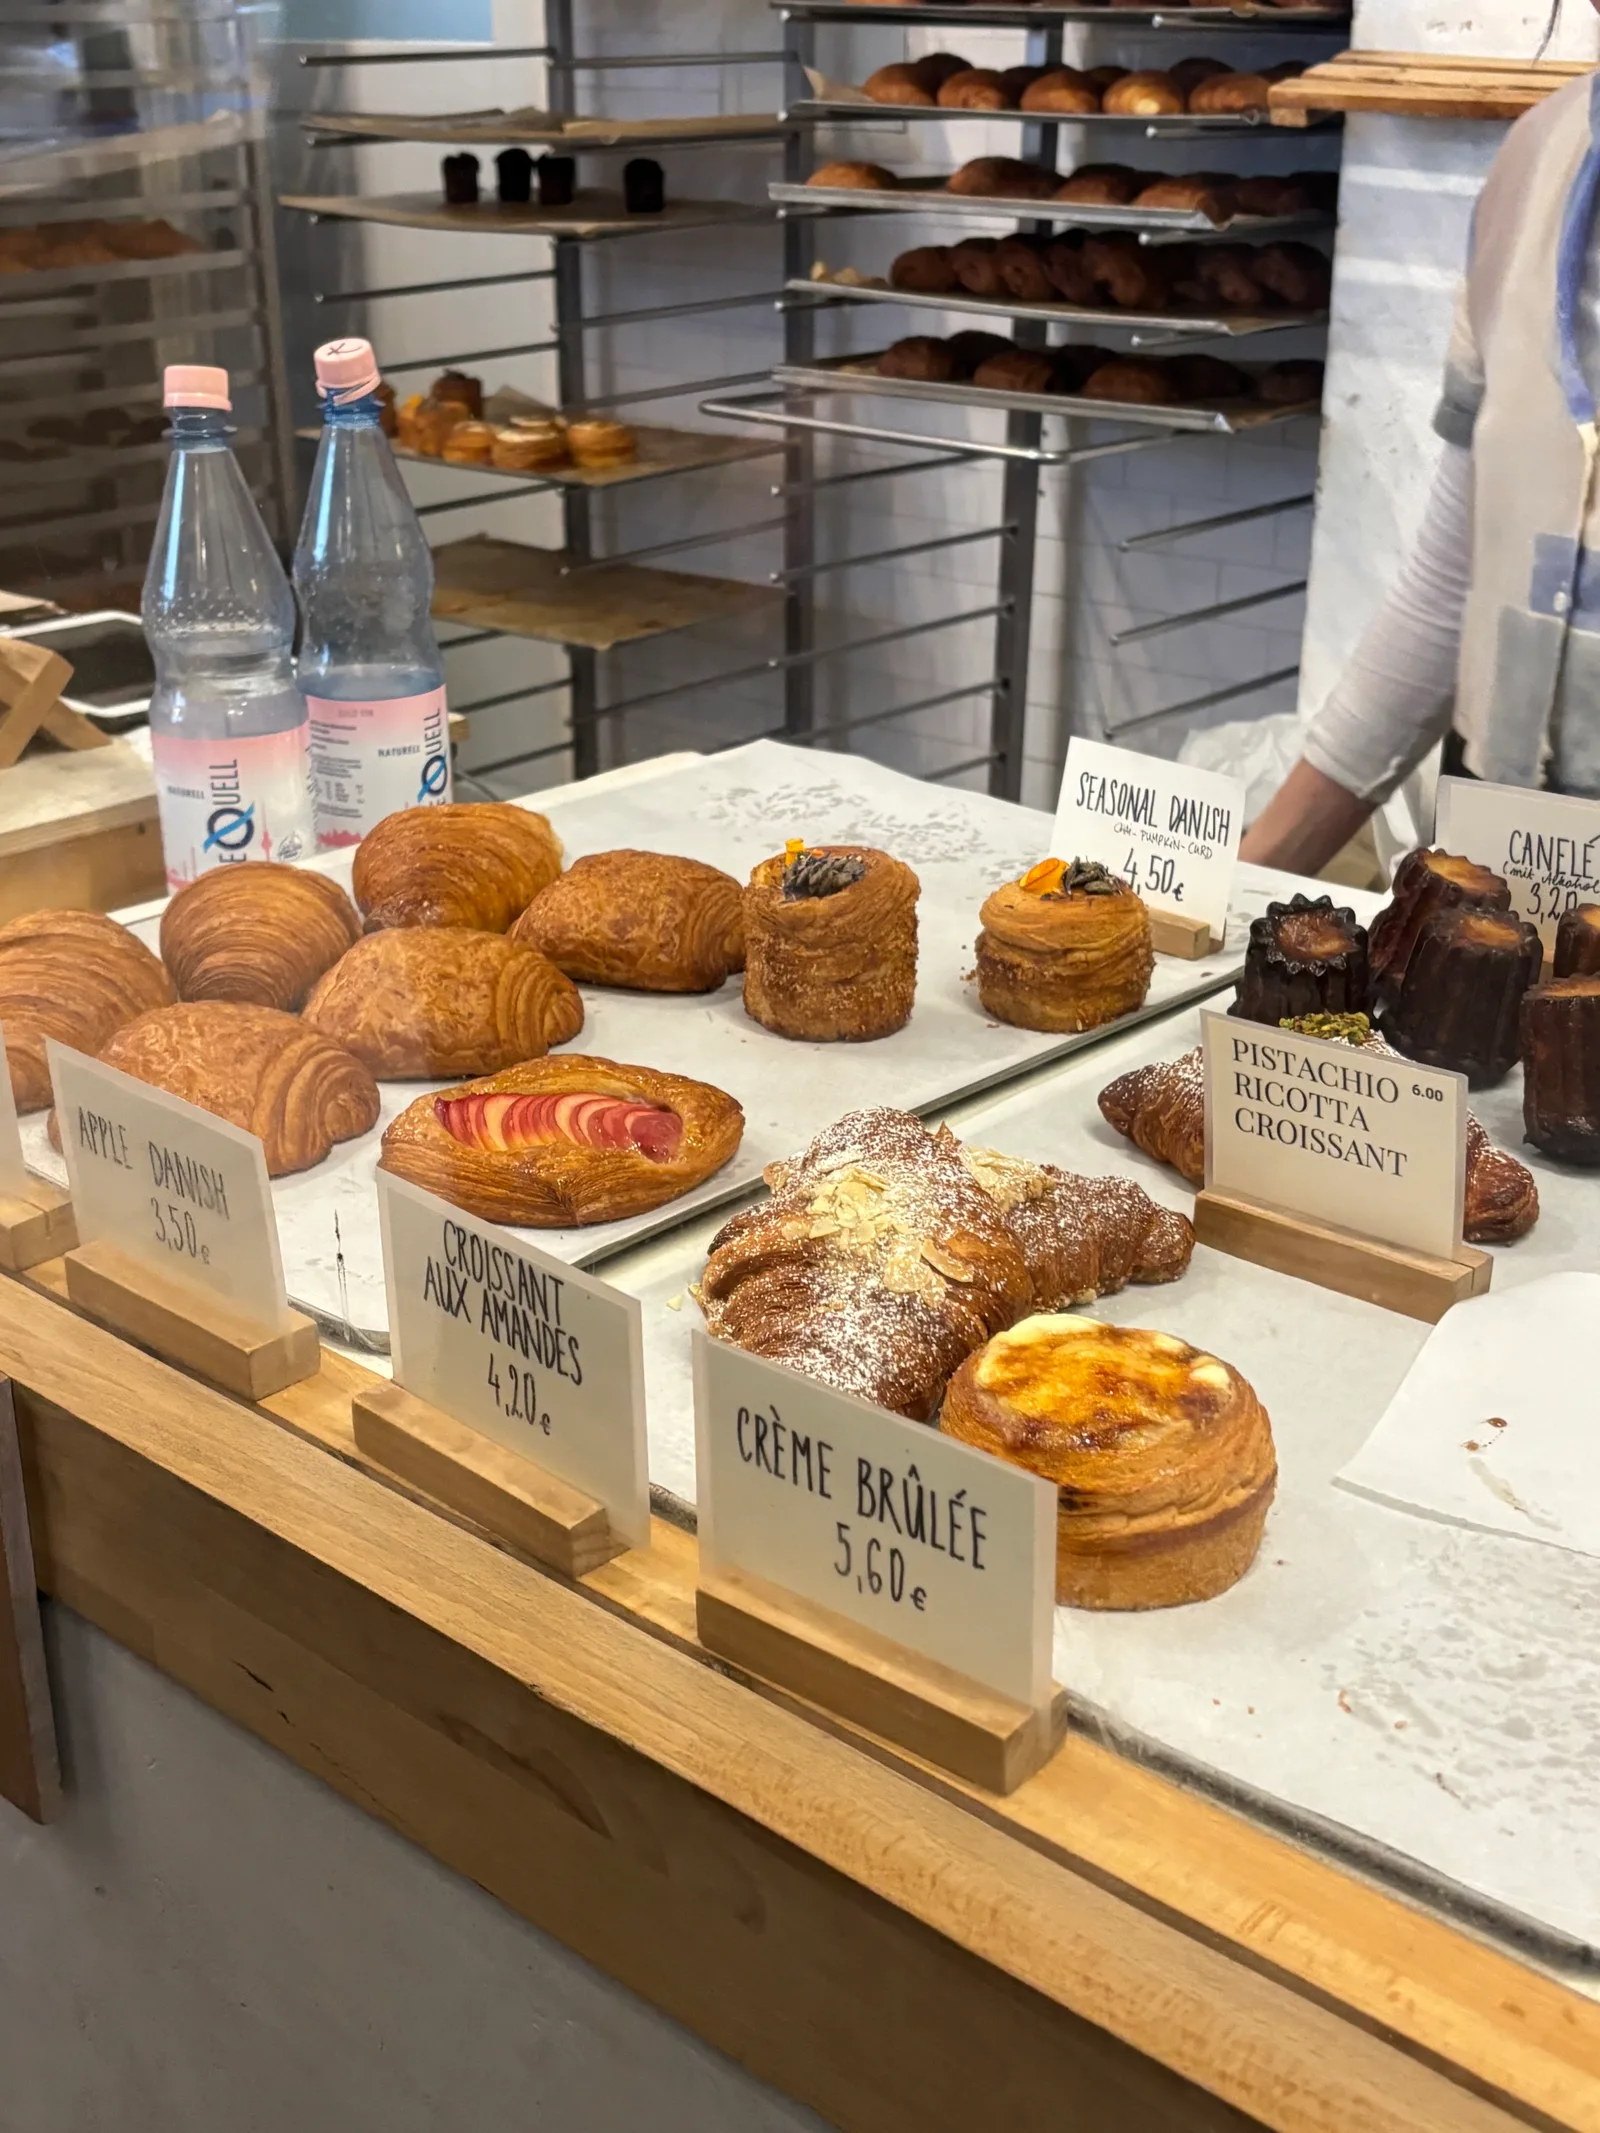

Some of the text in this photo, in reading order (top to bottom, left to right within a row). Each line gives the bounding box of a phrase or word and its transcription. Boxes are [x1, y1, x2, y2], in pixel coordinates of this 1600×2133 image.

[1076, 771, 1231, 847] SEASONAL DANISH
[1509, 829, 1600, 879] CANELÉ
[1231, 1037, 1400, 1104] PISTACHIO
[1233, 1071, 1371, 1133] RICOTTA
[1411, 1083, 1444, 1103] 6.00
[78, 1106, 230, 1221] APPLE DANISH
[1234, 1107, 1408, 1178] CROISSANT
[443, 1219, 565, 1326] CROISSANT
[423, 1255, 582, 1386] AUX AMANDES
[736, 1404, 988, 1570] CRÈME BRÛLÉE
